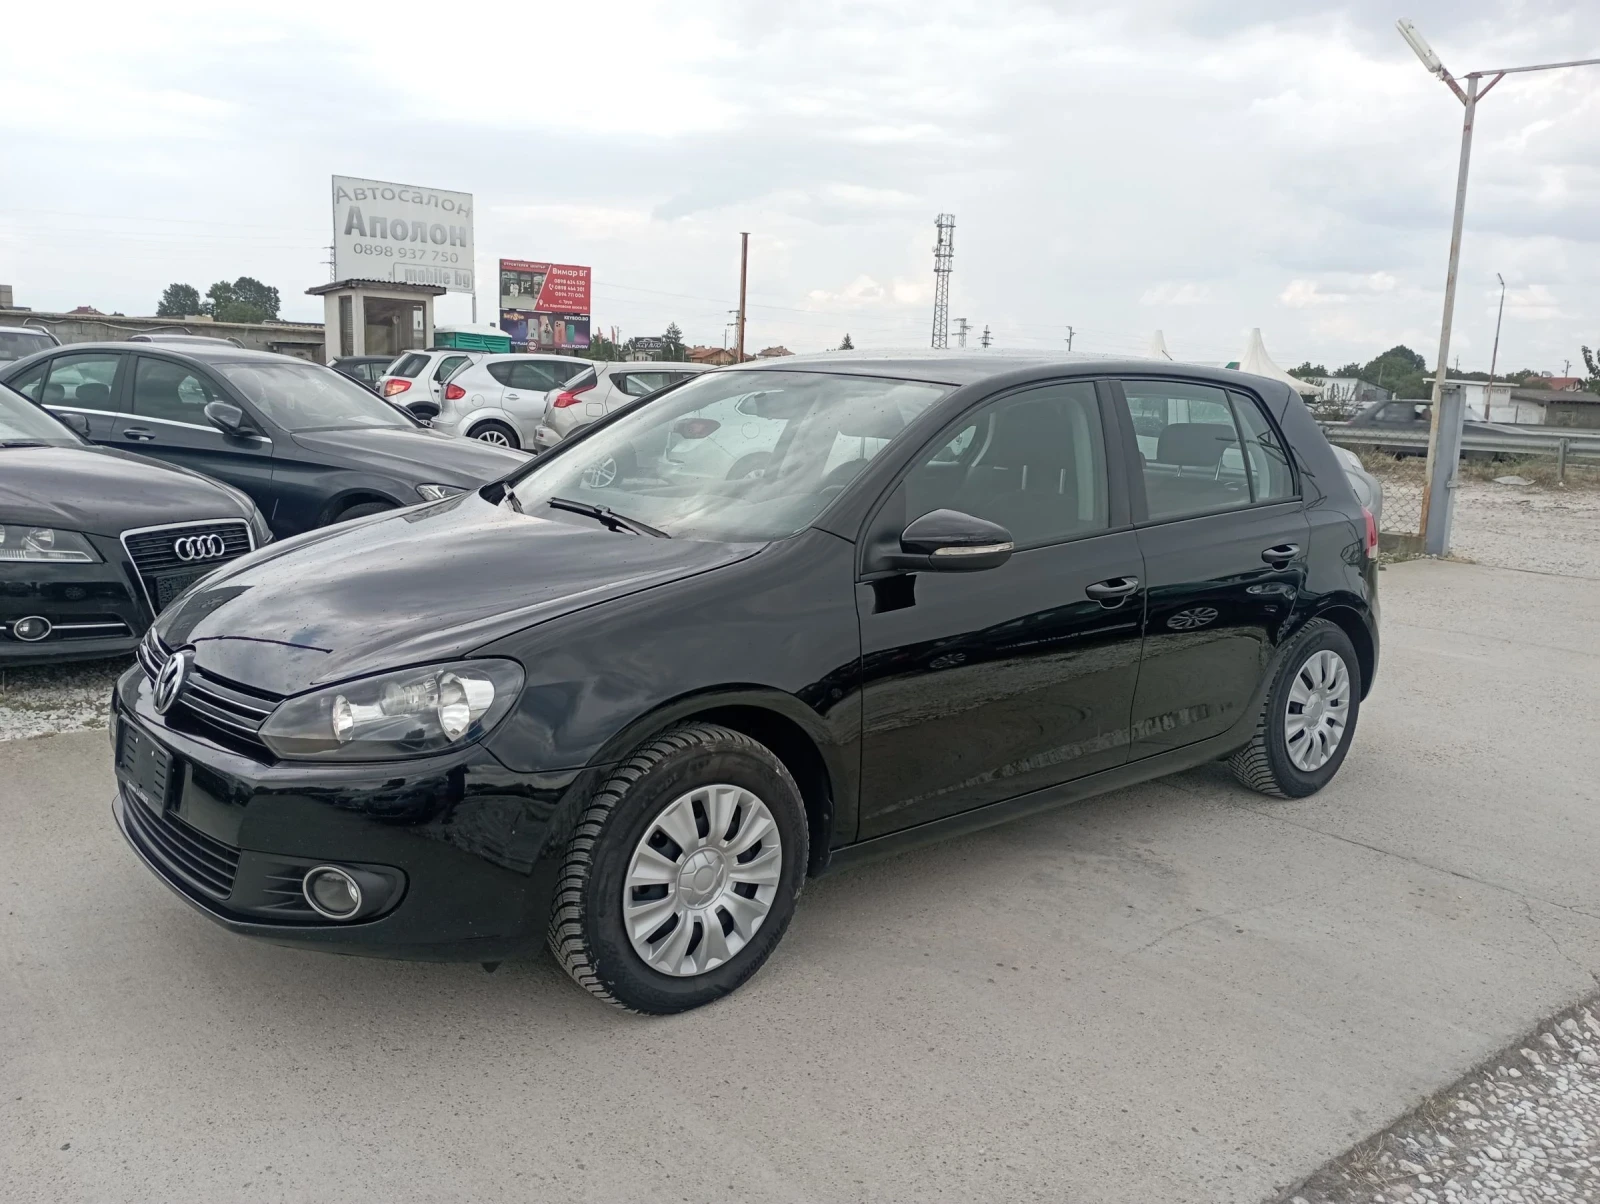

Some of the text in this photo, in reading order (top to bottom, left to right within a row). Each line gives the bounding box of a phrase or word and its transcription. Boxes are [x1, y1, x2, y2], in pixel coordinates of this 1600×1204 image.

[336, 185, 471, 219] Автосалон
[344, 205, 467, 248] Аполон
[353, 242, 459, 264] 0898 937 750
[404, 267, 451, 285] mobile
[552, 267, 578, 277] Вимар
